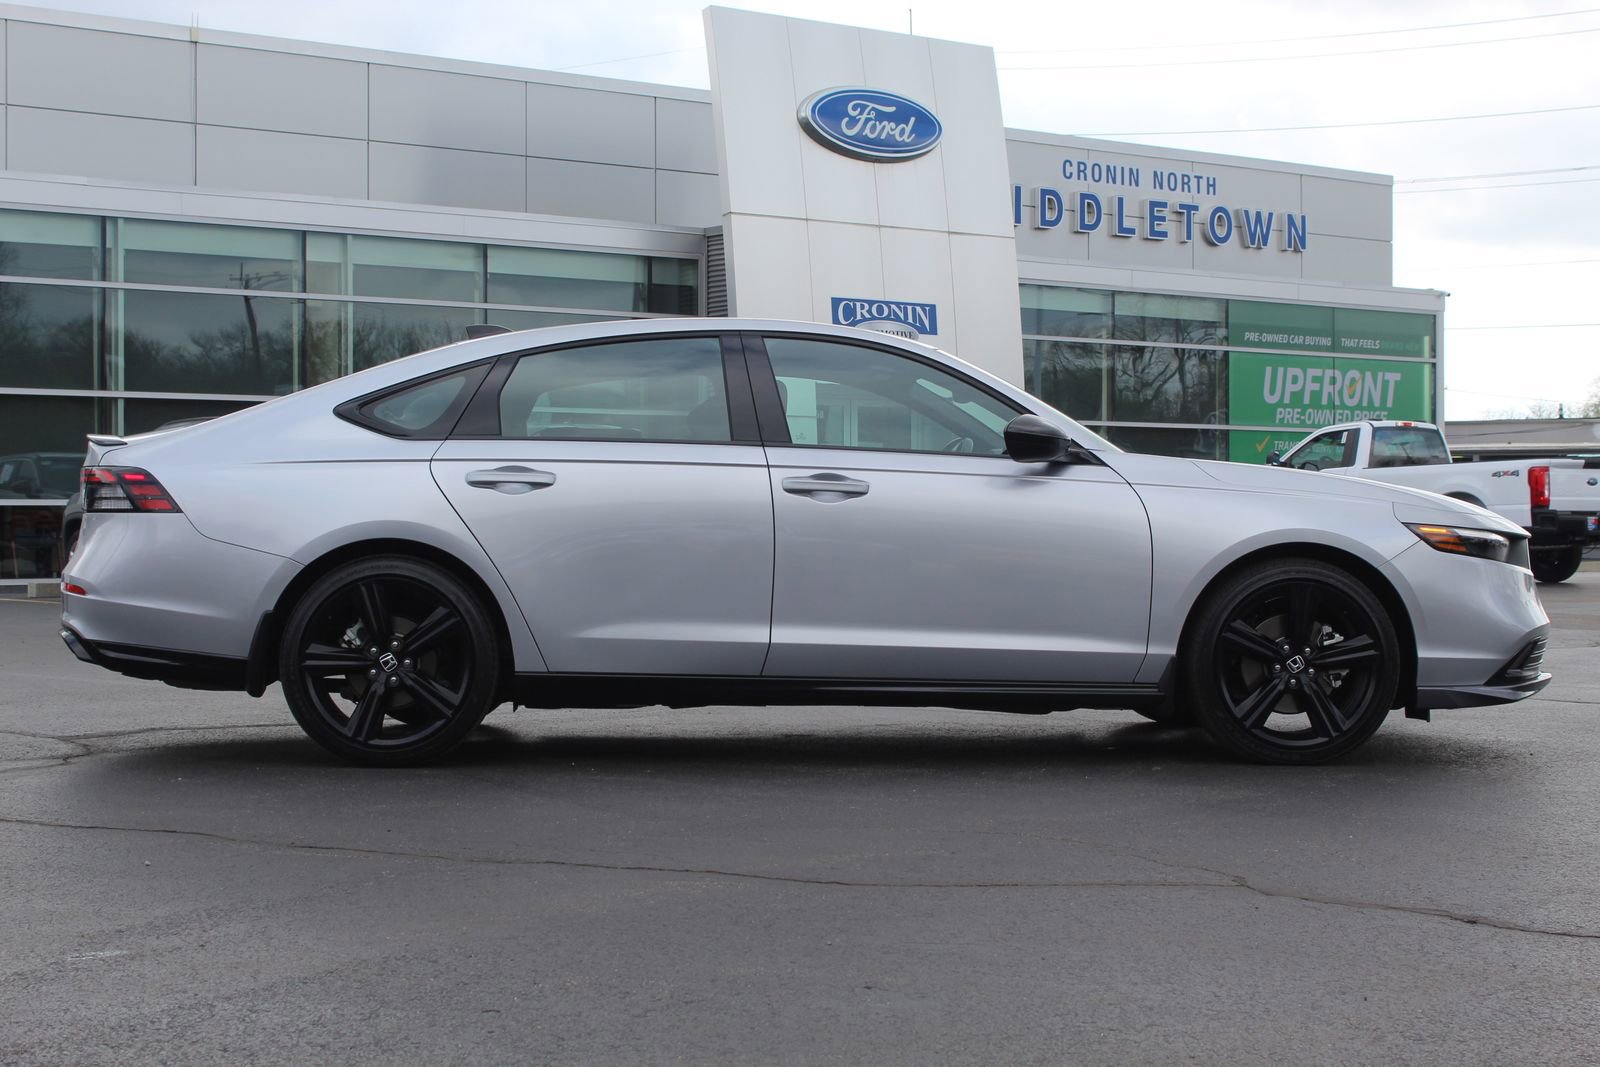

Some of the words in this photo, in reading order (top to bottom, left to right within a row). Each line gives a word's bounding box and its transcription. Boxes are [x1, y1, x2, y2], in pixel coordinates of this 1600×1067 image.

[841, 100, 916, 142] Ford
[1062, 159, 1140, 187] CRONIN
[1153, 170, 1217, 196] NORTH
[1013, 184, 1308, 251] IDDLETOWN
[837, 300, 931, 332] CRONIN
[1244, 331, 1289, 345] PRE-OWNED
[1289, 335, 1304, 345] CAR
[1305, 336, 1332, 346] BUYING
[1341, 337, 1358, 348] THAT
[1359, 339, 1380, 349] FEELS
[1263, 366, 1401, 407] UPFRONT
[1276, 408, 1350, 424] PRE-OWNED
